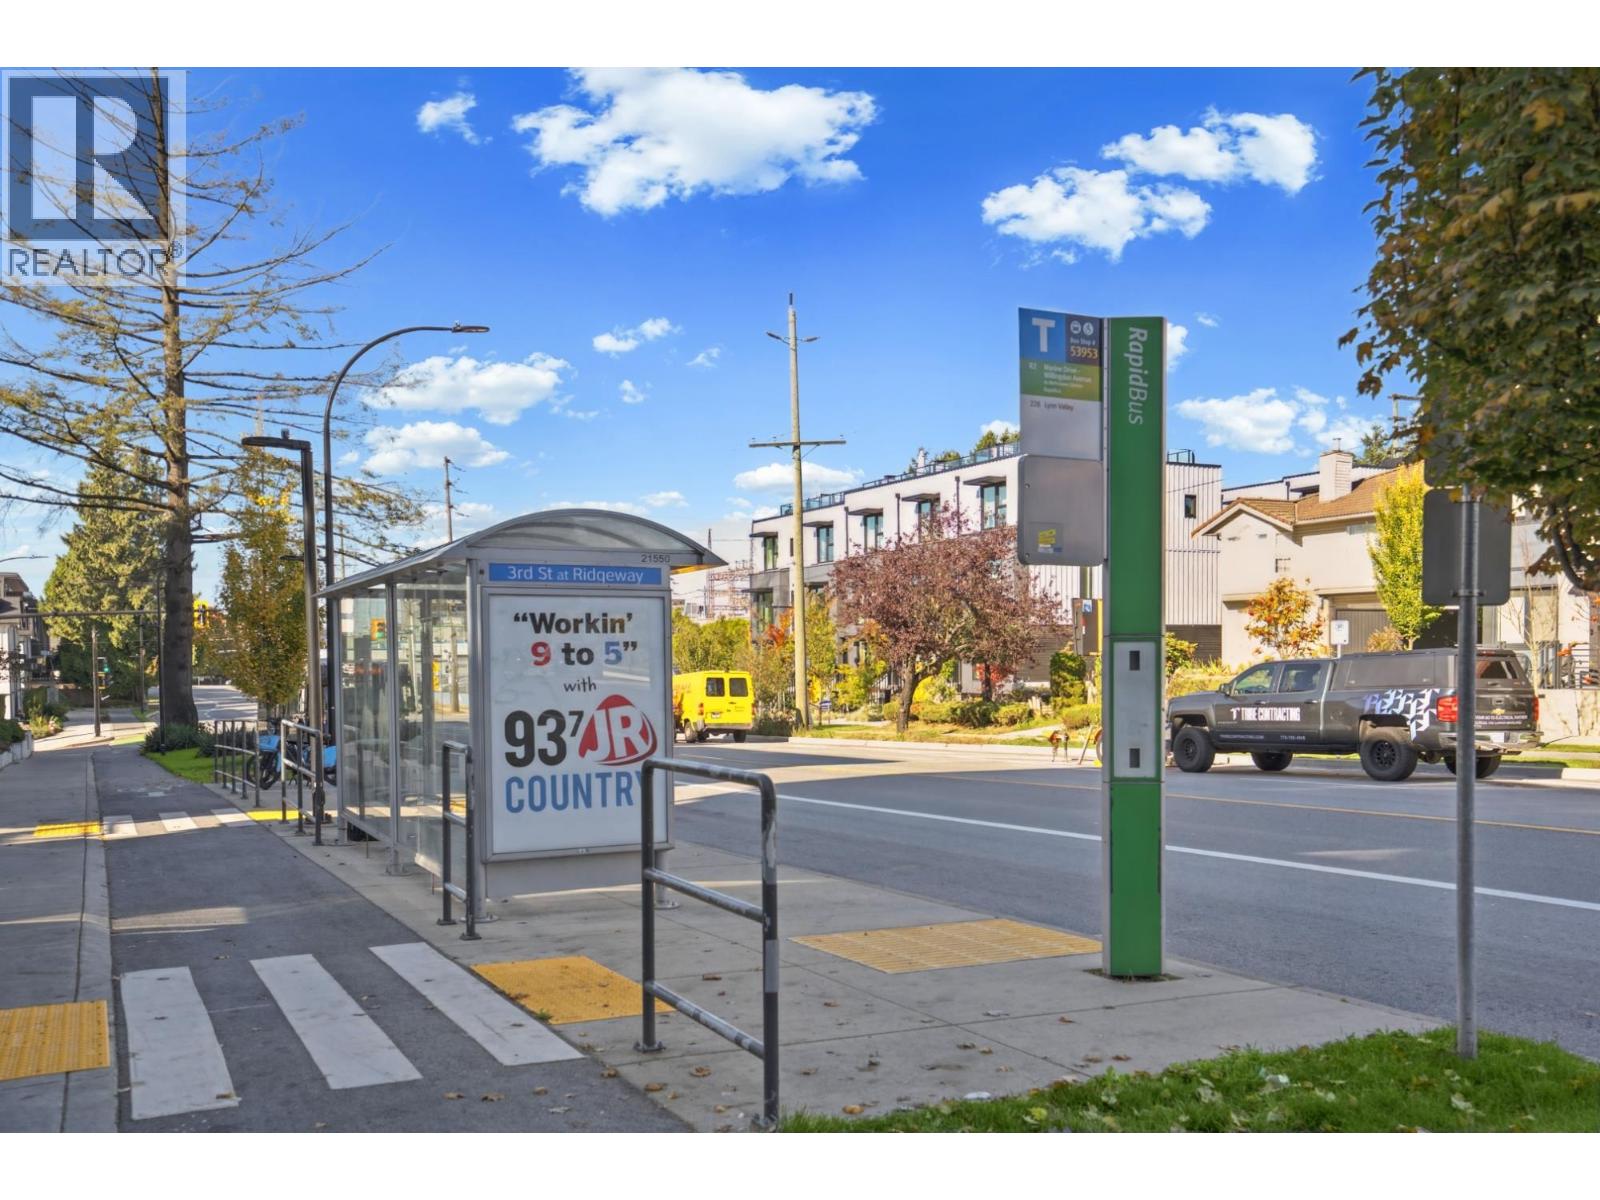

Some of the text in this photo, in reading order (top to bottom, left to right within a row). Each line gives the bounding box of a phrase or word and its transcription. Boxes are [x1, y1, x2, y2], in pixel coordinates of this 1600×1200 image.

[1032, 317, 1056, 353] T
[1070, 346, 1098, 358] 53953
[1124, 327, 1148, 425] RapidBus
[641, 554, 670, 563] 21550
[507, 566, 644, 584] 3rd St at Ridgeway
[531, 641, 552, 666] 9
[561, 642, 595, 666] to
[564, 676, 597, 693] with
[506, 771, 642, 814] COUNTR
